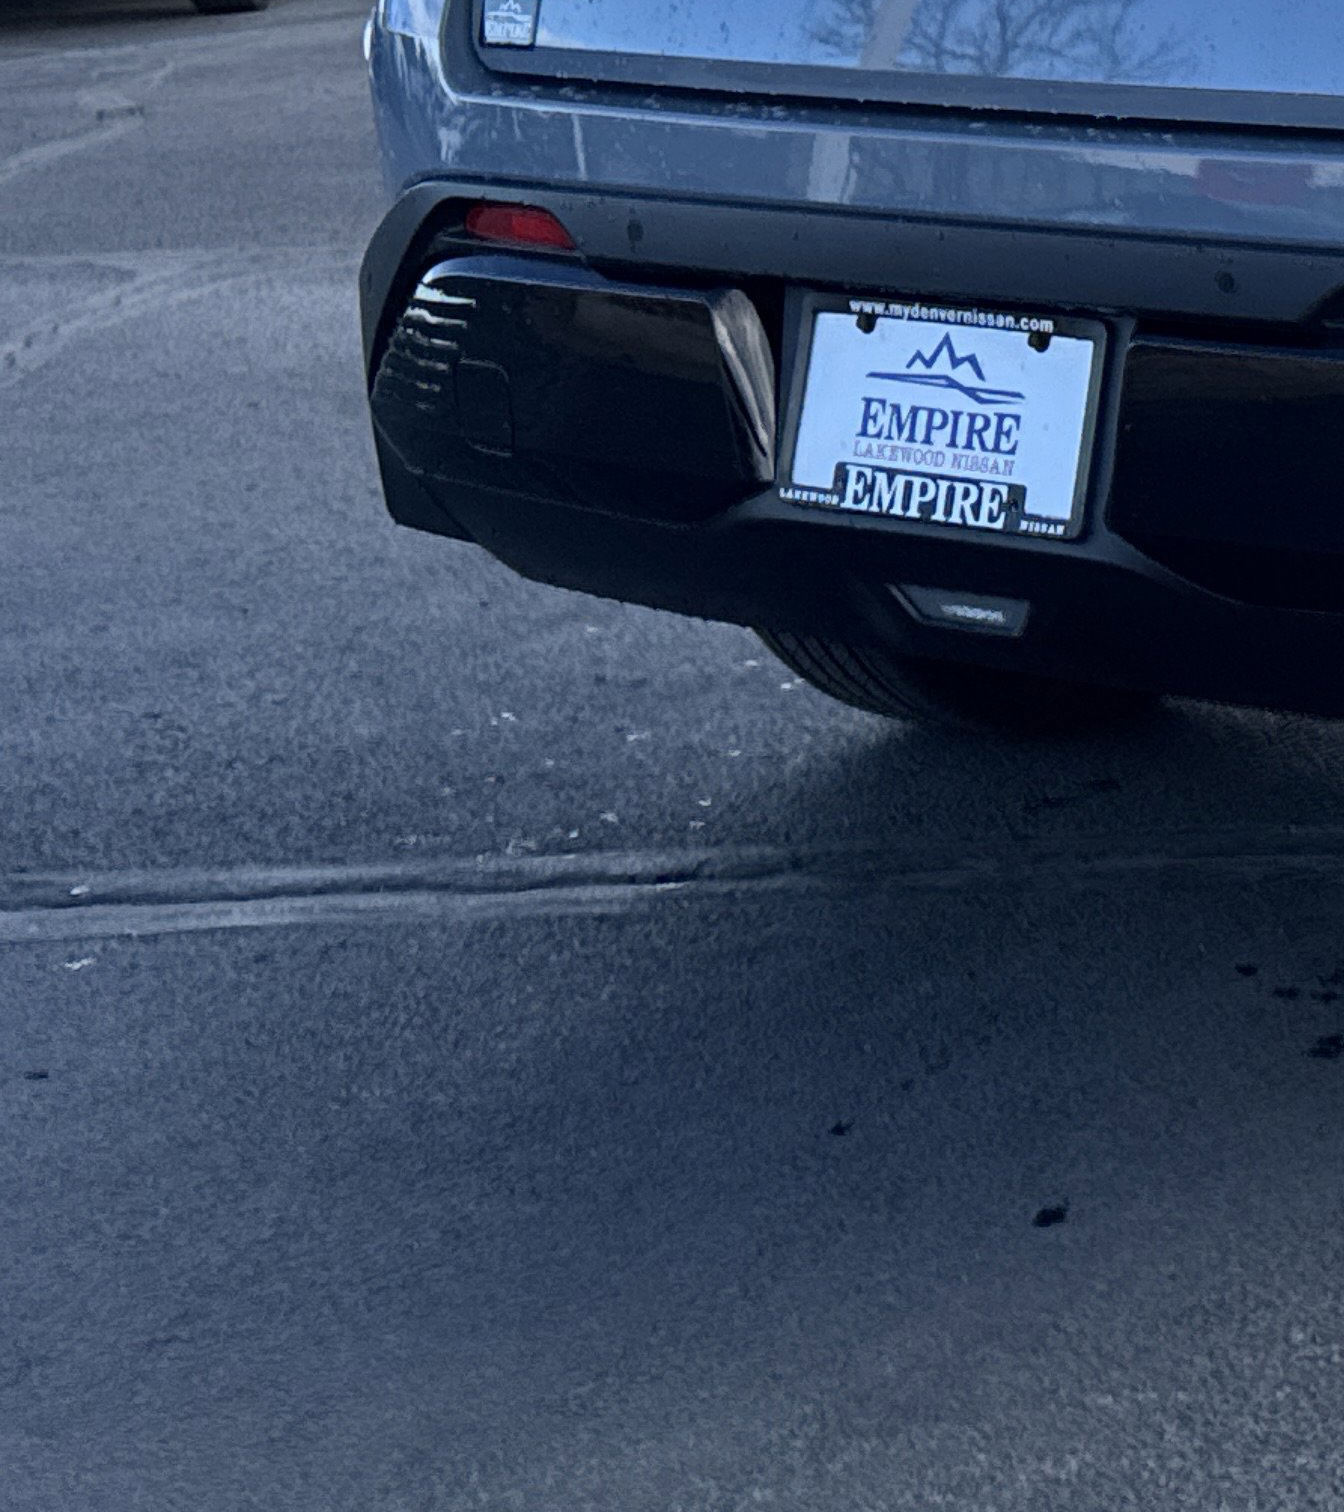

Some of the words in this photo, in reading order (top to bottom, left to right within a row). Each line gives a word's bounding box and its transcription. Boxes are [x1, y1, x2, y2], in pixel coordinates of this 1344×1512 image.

[856, 397, 1020, 455] EMPIRE
[853, 440, 945, 468] LAKEWOOD
[951, 453, 1015, 476] NISSAN
[842, 465, 1008, 529] EMPIRE
